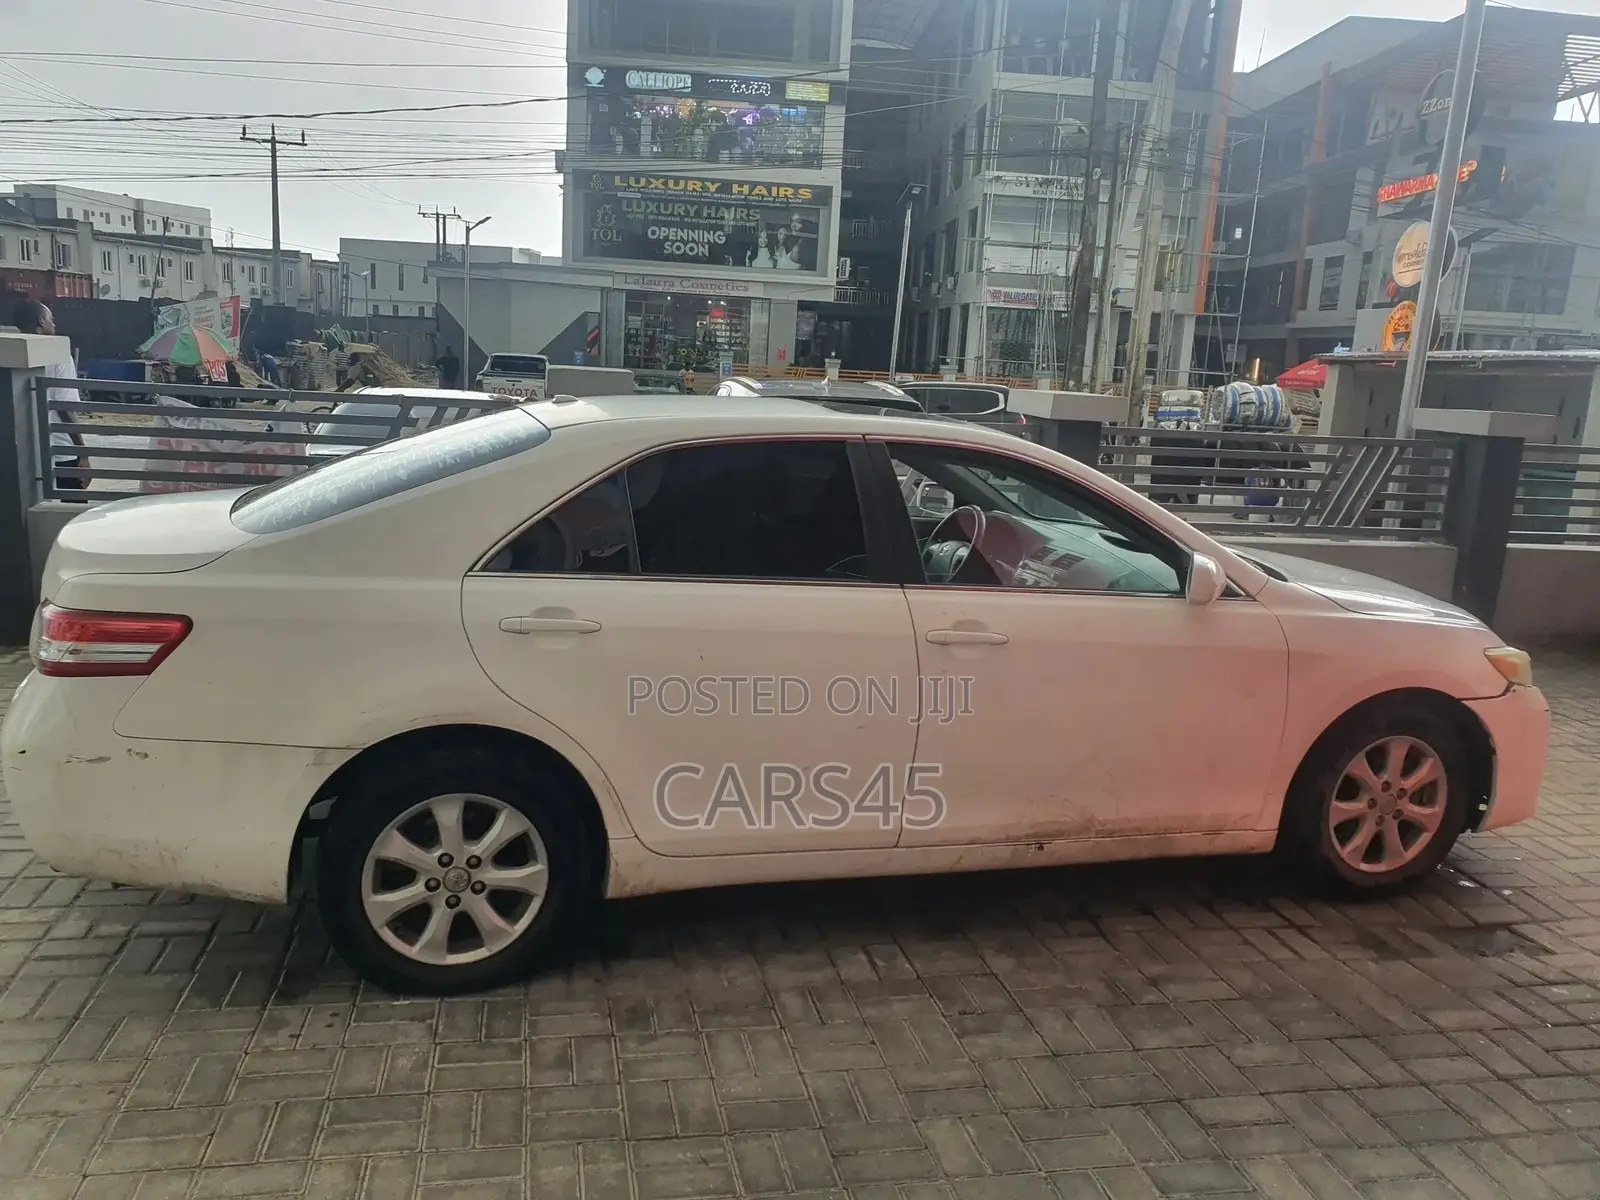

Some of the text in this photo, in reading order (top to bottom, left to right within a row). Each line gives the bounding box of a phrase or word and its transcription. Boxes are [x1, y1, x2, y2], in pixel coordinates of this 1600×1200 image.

[626, 70, 692, 92] CALLIOPE
[614, 175, 813, 199] LUXURY HAIRS
[621, 199, 699, 217] LUXURY
[702, 205, 761, 221] HAIRS
[591, 228, 622, 242] TOL
[648, 226, 726, 244] OPENNING
[664, 241, 709, 257] SOON
[680, 278, 749, 292] Cosmetics
[492, 386, 538, 398] TOYOTA
